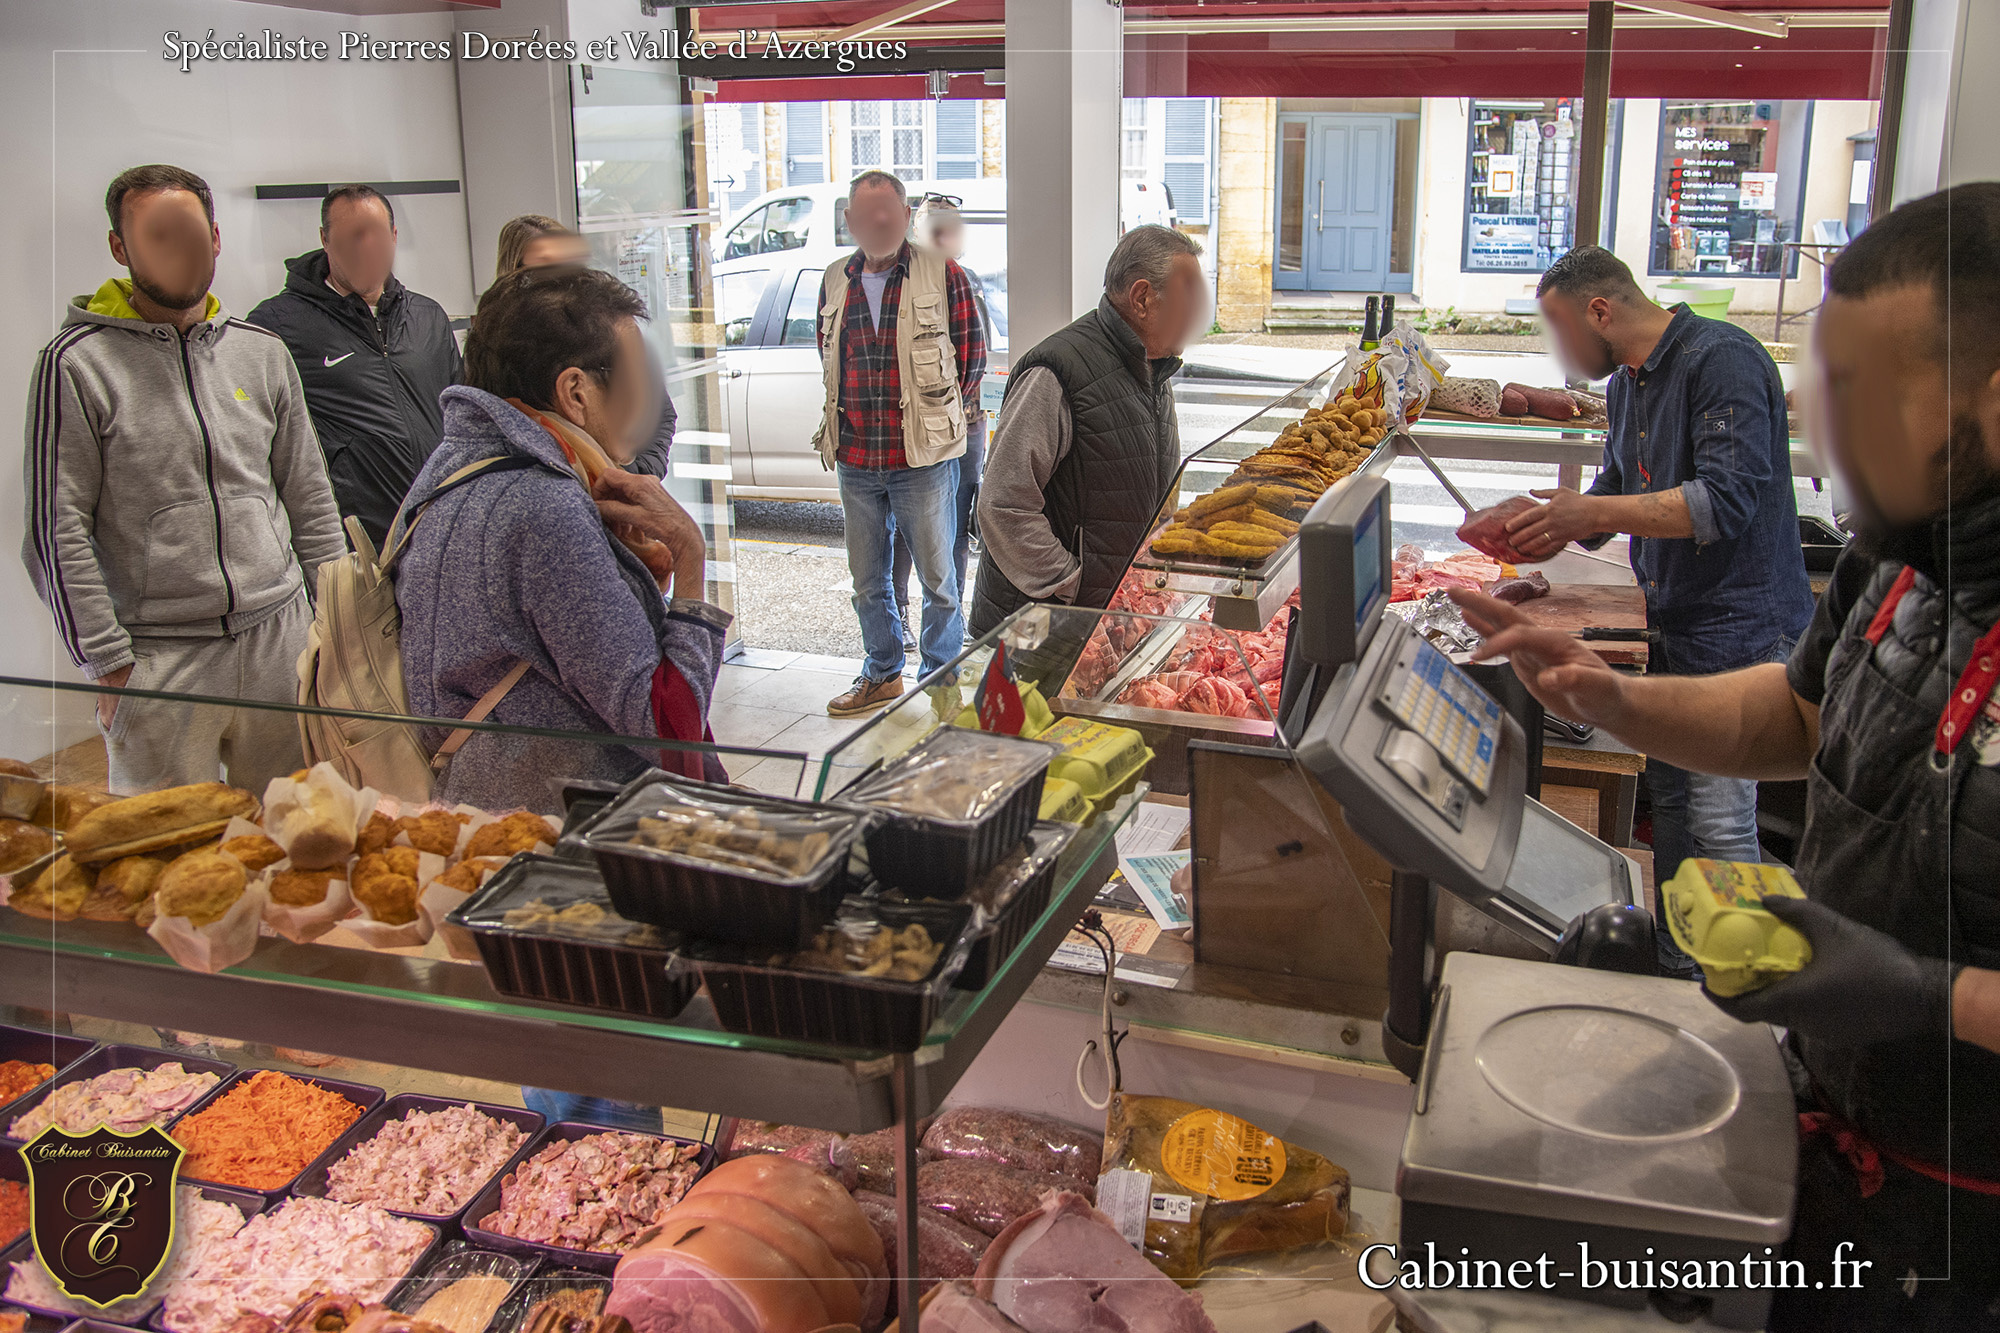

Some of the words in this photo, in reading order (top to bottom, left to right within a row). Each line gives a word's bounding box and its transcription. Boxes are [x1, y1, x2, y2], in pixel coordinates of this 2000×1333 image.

[1675, 127, 1697, 138] MES
[1674, 138, 1730, 151] services
[1472, 216, 1500, 225] Pascal
[1501, 217, 1538, 225] LITERIE
[1234, 1155, 1273, 1186] 100
